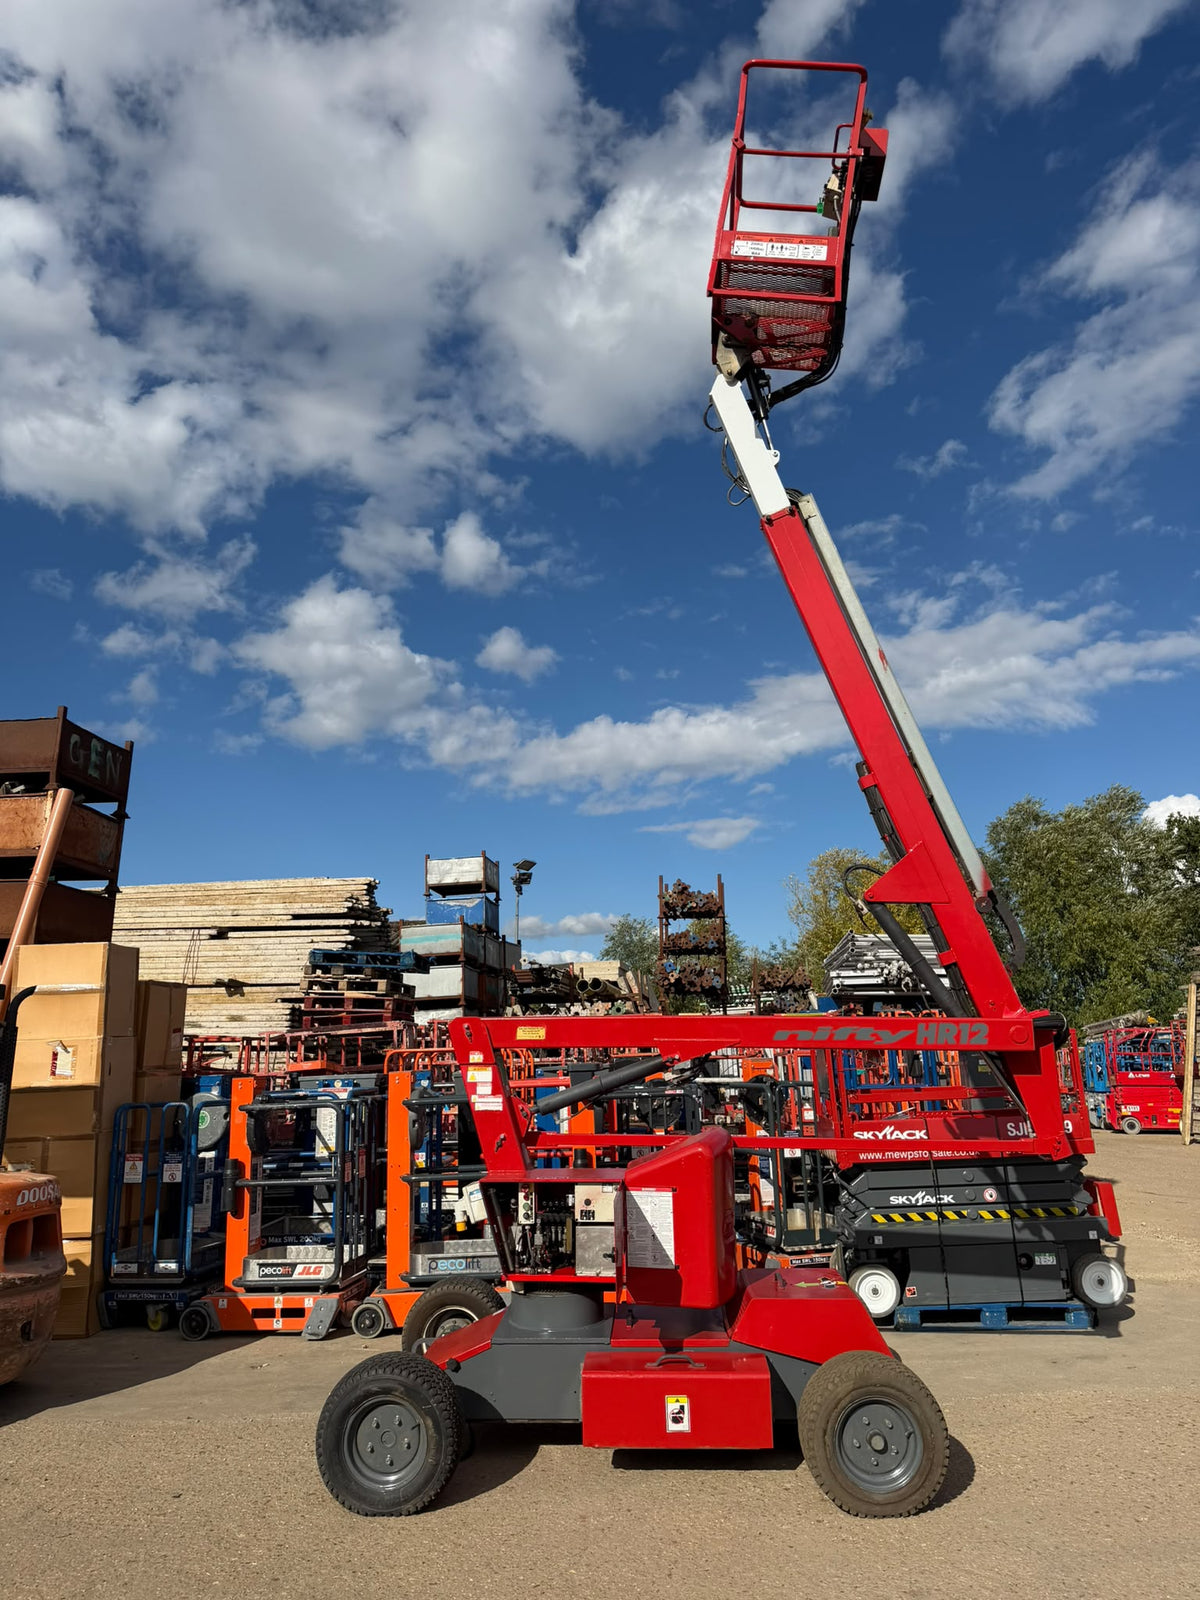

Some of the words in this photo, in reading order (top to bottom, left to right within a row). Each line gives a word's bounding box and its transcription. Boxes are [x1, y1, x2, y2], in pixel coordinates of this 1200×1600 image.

[69, 734, 123, 785] GEN
[772, 1026, 915, 1045] nifty
[915, 1022, 989, 1045] HR12
[853, 1125, 928, 1140] SKYJACK
[889, 1190, 956, 1206] SKYJACK
[260, 1265, 292, 1277] pecolift
[297, 1265, 324, 1276] JLG
[428, 1257, 482, 1274] pecolift
